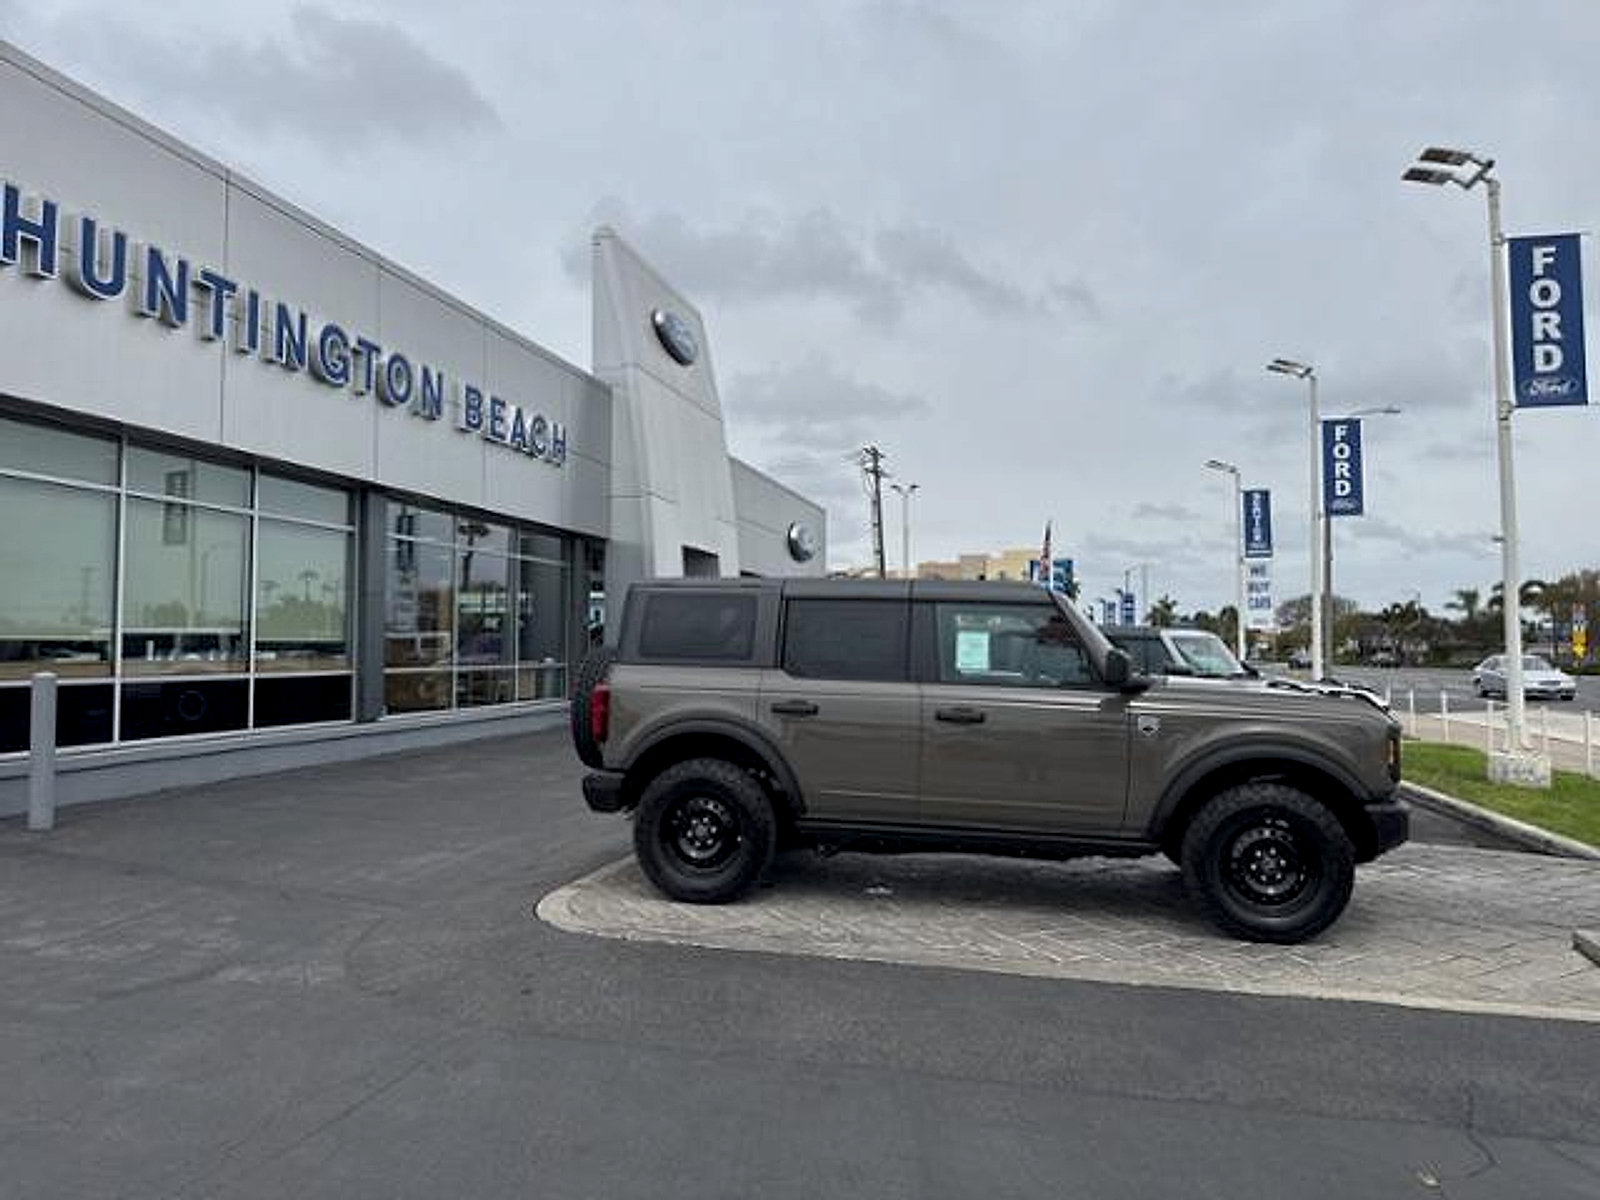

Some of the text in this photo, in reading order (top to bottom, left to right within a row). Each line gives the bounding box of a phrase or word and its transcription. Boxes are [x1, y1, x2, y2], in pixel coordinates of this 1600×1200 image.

[2, 183, 566, 462] HUNTINGTON BEACH
[1530, 246, 1563, 373] FORD
[1333, 425, 1351, 496] FORD
